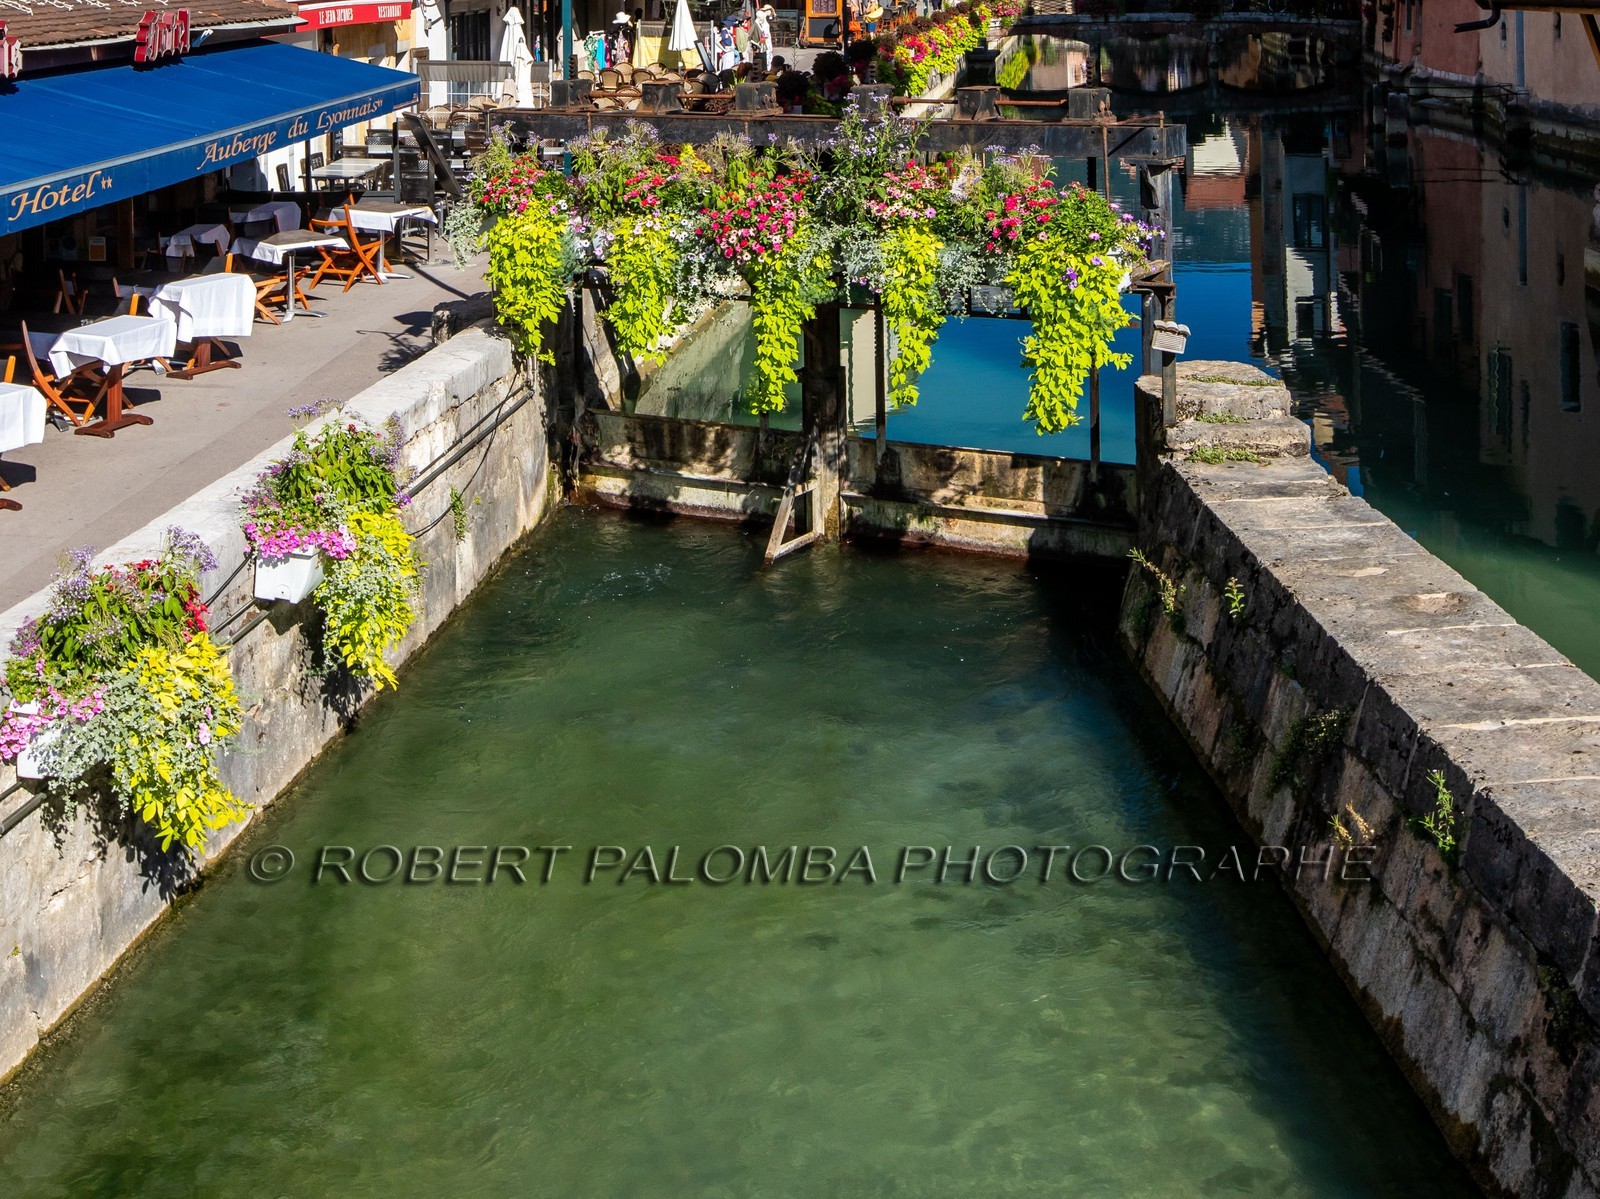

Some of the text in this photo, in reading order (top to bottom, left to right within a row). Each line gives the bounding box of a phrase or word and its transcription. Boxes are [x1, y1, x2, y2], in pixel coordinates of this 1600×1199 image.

[318, 11, 325, 25] LE
[196, 98, 378, 170] Auberge du Lyonnais
[7, 171, 102, 222] Hotel
